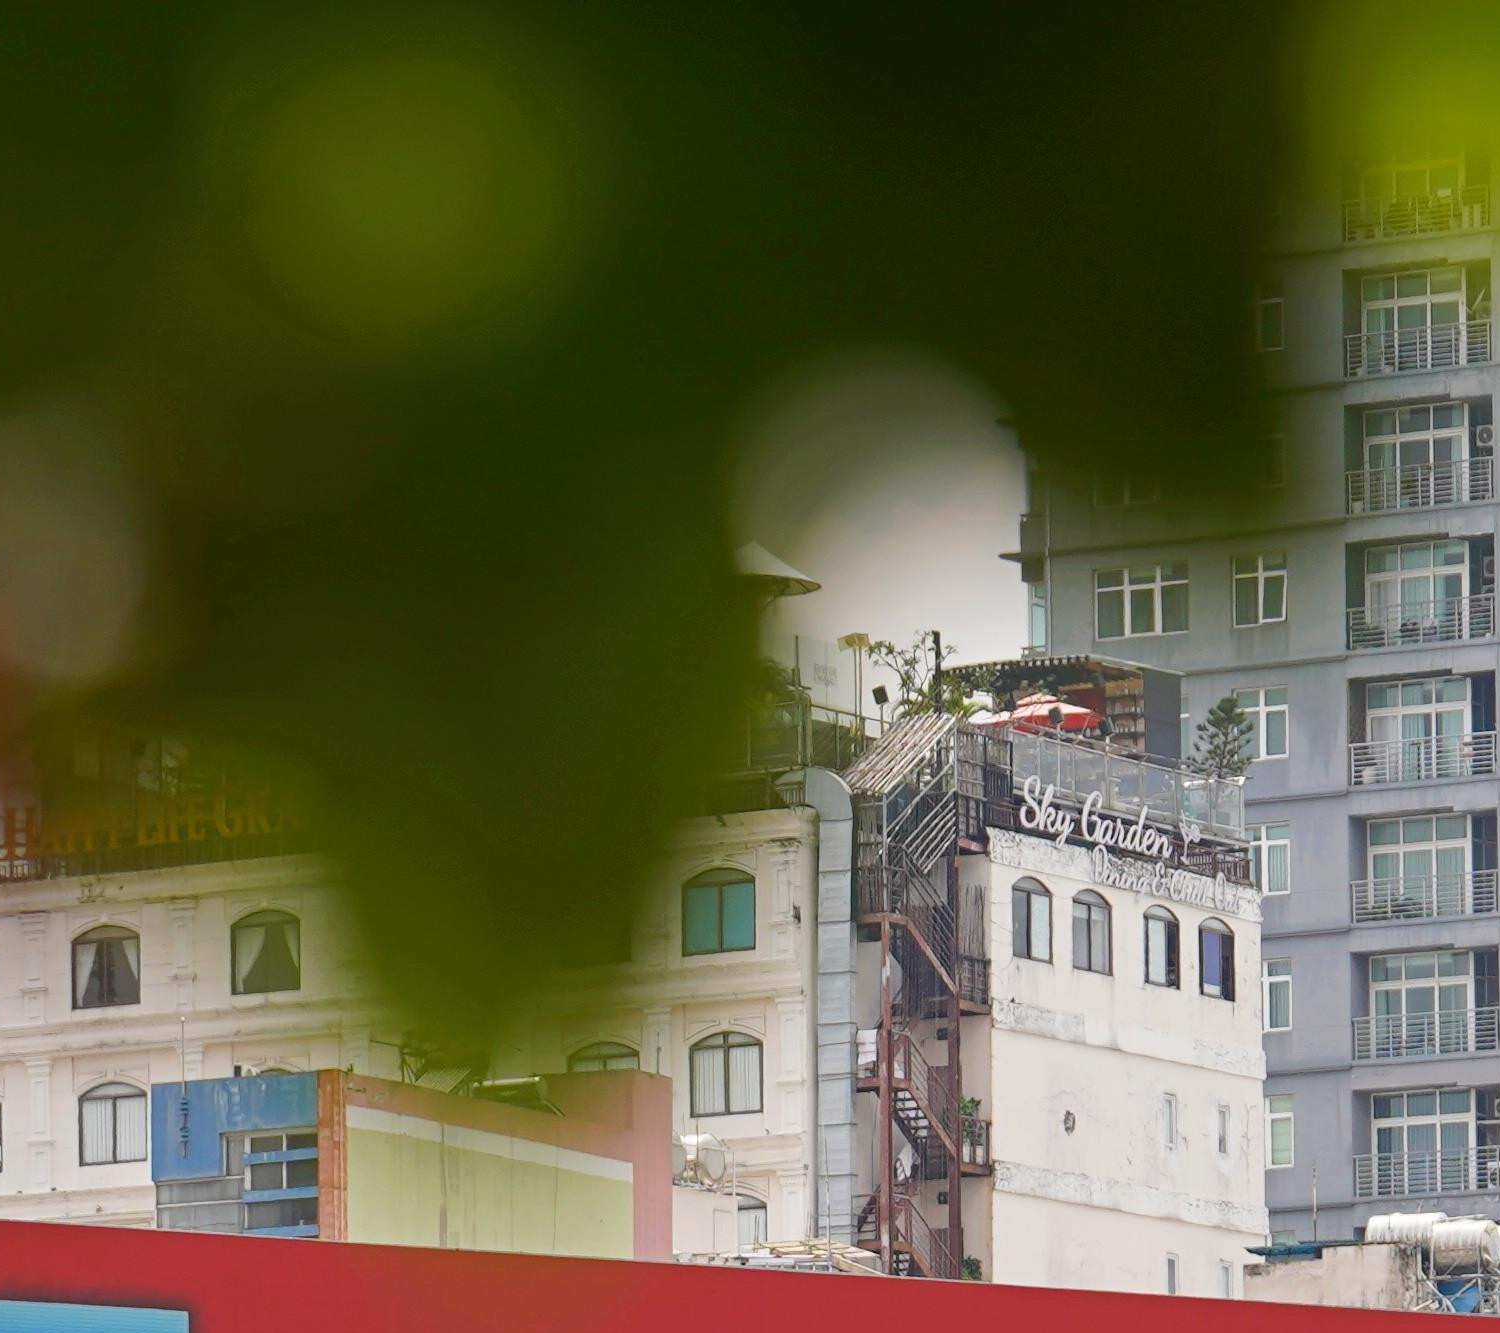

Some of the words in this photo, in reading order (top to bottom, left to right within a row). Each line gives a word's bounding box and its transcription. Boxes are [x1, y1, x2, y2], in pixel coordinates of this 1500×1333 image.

[1019, 775, 1074, 848] Sky
[1081, 790, 1172, 858] Garden
[1092, 845, 1151, 895] Dining
